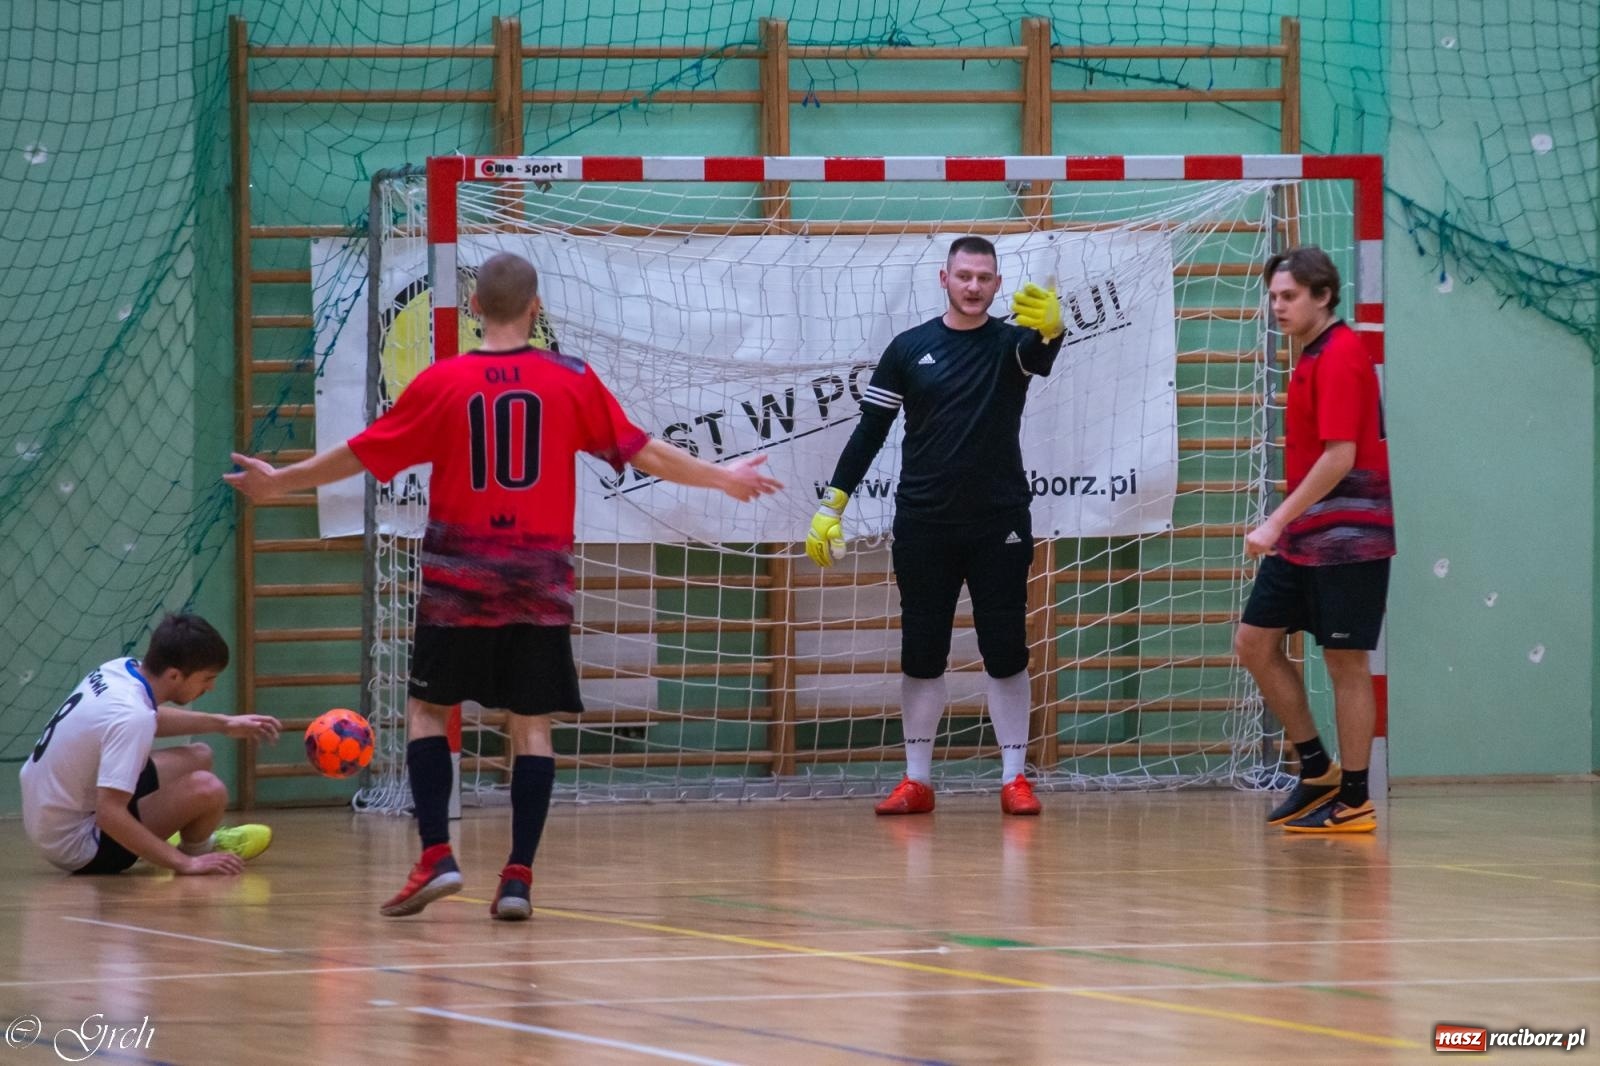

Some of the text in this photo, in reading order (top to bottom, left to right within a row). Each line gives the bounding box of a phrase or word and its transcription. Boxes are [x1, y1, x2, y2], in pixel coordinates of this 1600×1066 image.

[524, 162, 562, 176] sport
[485, 366, 521, 383] OLI
[741, 387, 794, 440] W
[467, 389, 542, 492] 10
[32, 692, 84, 763] 8
